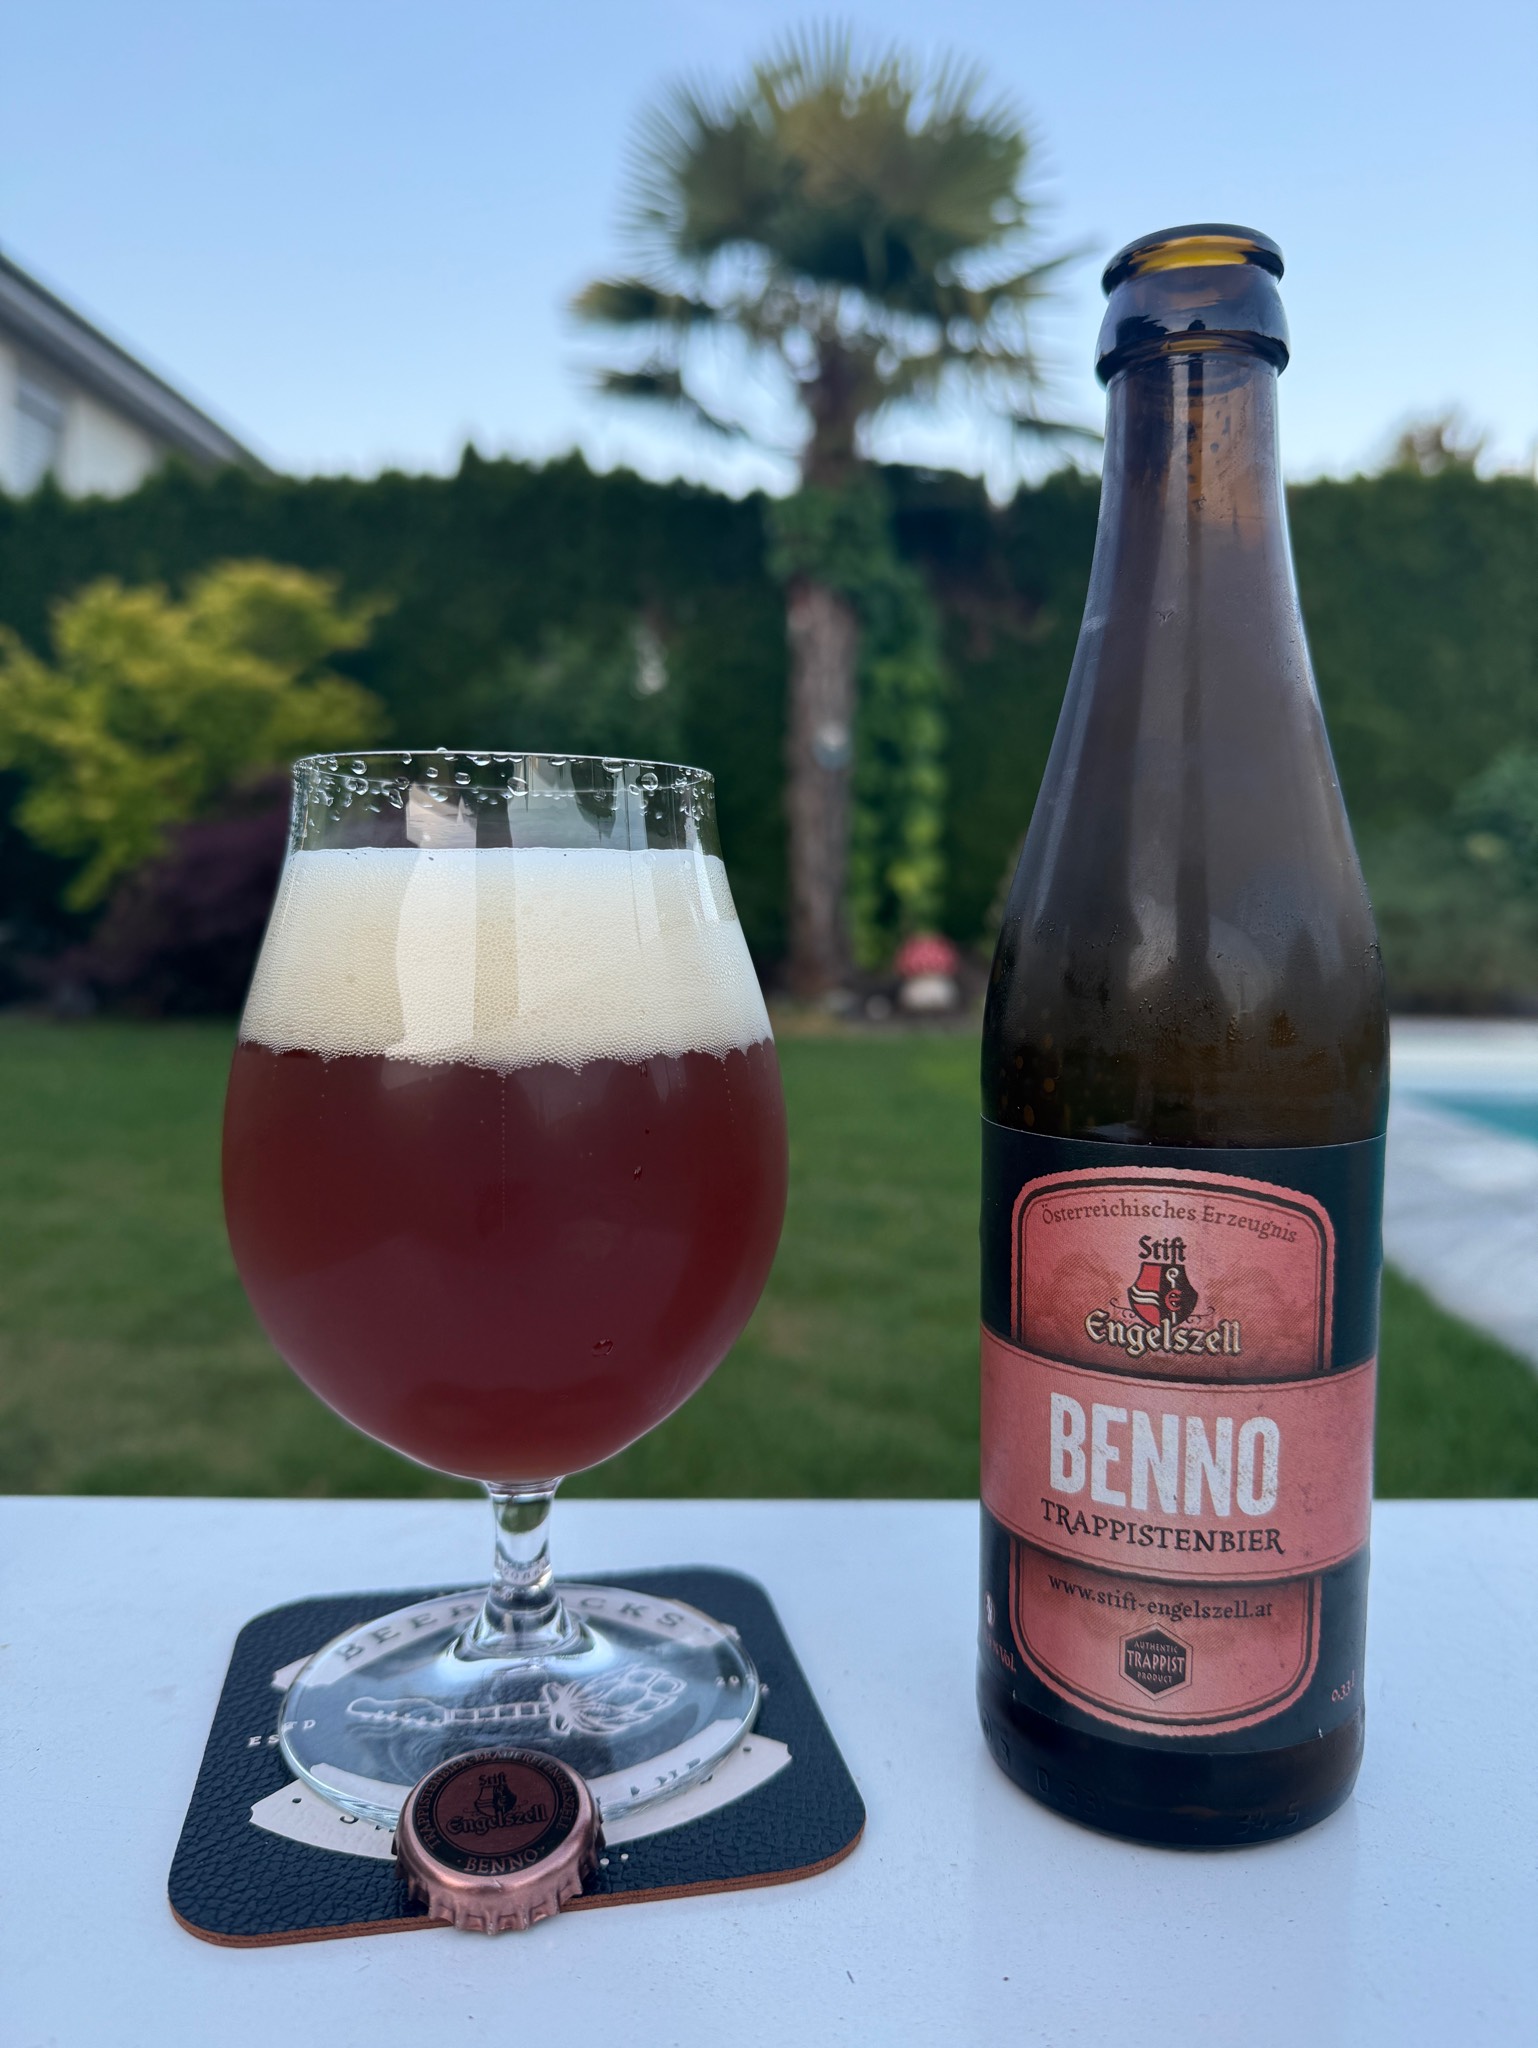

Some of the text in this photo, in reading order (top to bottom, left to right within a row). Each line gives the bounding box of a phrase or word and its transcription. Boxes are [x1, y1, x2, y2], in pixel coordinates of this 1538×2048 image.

[1042, 1199, 1298, 1243] Österreichisches Erzeugnis
[1138, 1235, 1187, 1265] Stift
[1084, 1308, 1243, 1358] Engelszell
[1050, 1392, 1280, 1518] BENNO
[1040, 1498, 1285, 1555] TRAPPISTENBIER
[1047, 1574, 1273, 1622] www.stift-engelszell.at
[1126, 1649, 1185, 1674] TRAPPIST
[1133, 1640, 1179, 1655] AUTHENTIC
[1136, 1671, 1173, 1684] PRODUCT
[478, 1771, 508, 1787] Stift
[446, 1803, 548, 1836] Engelszell
[463, 1848, 539, 1874] BENNO
